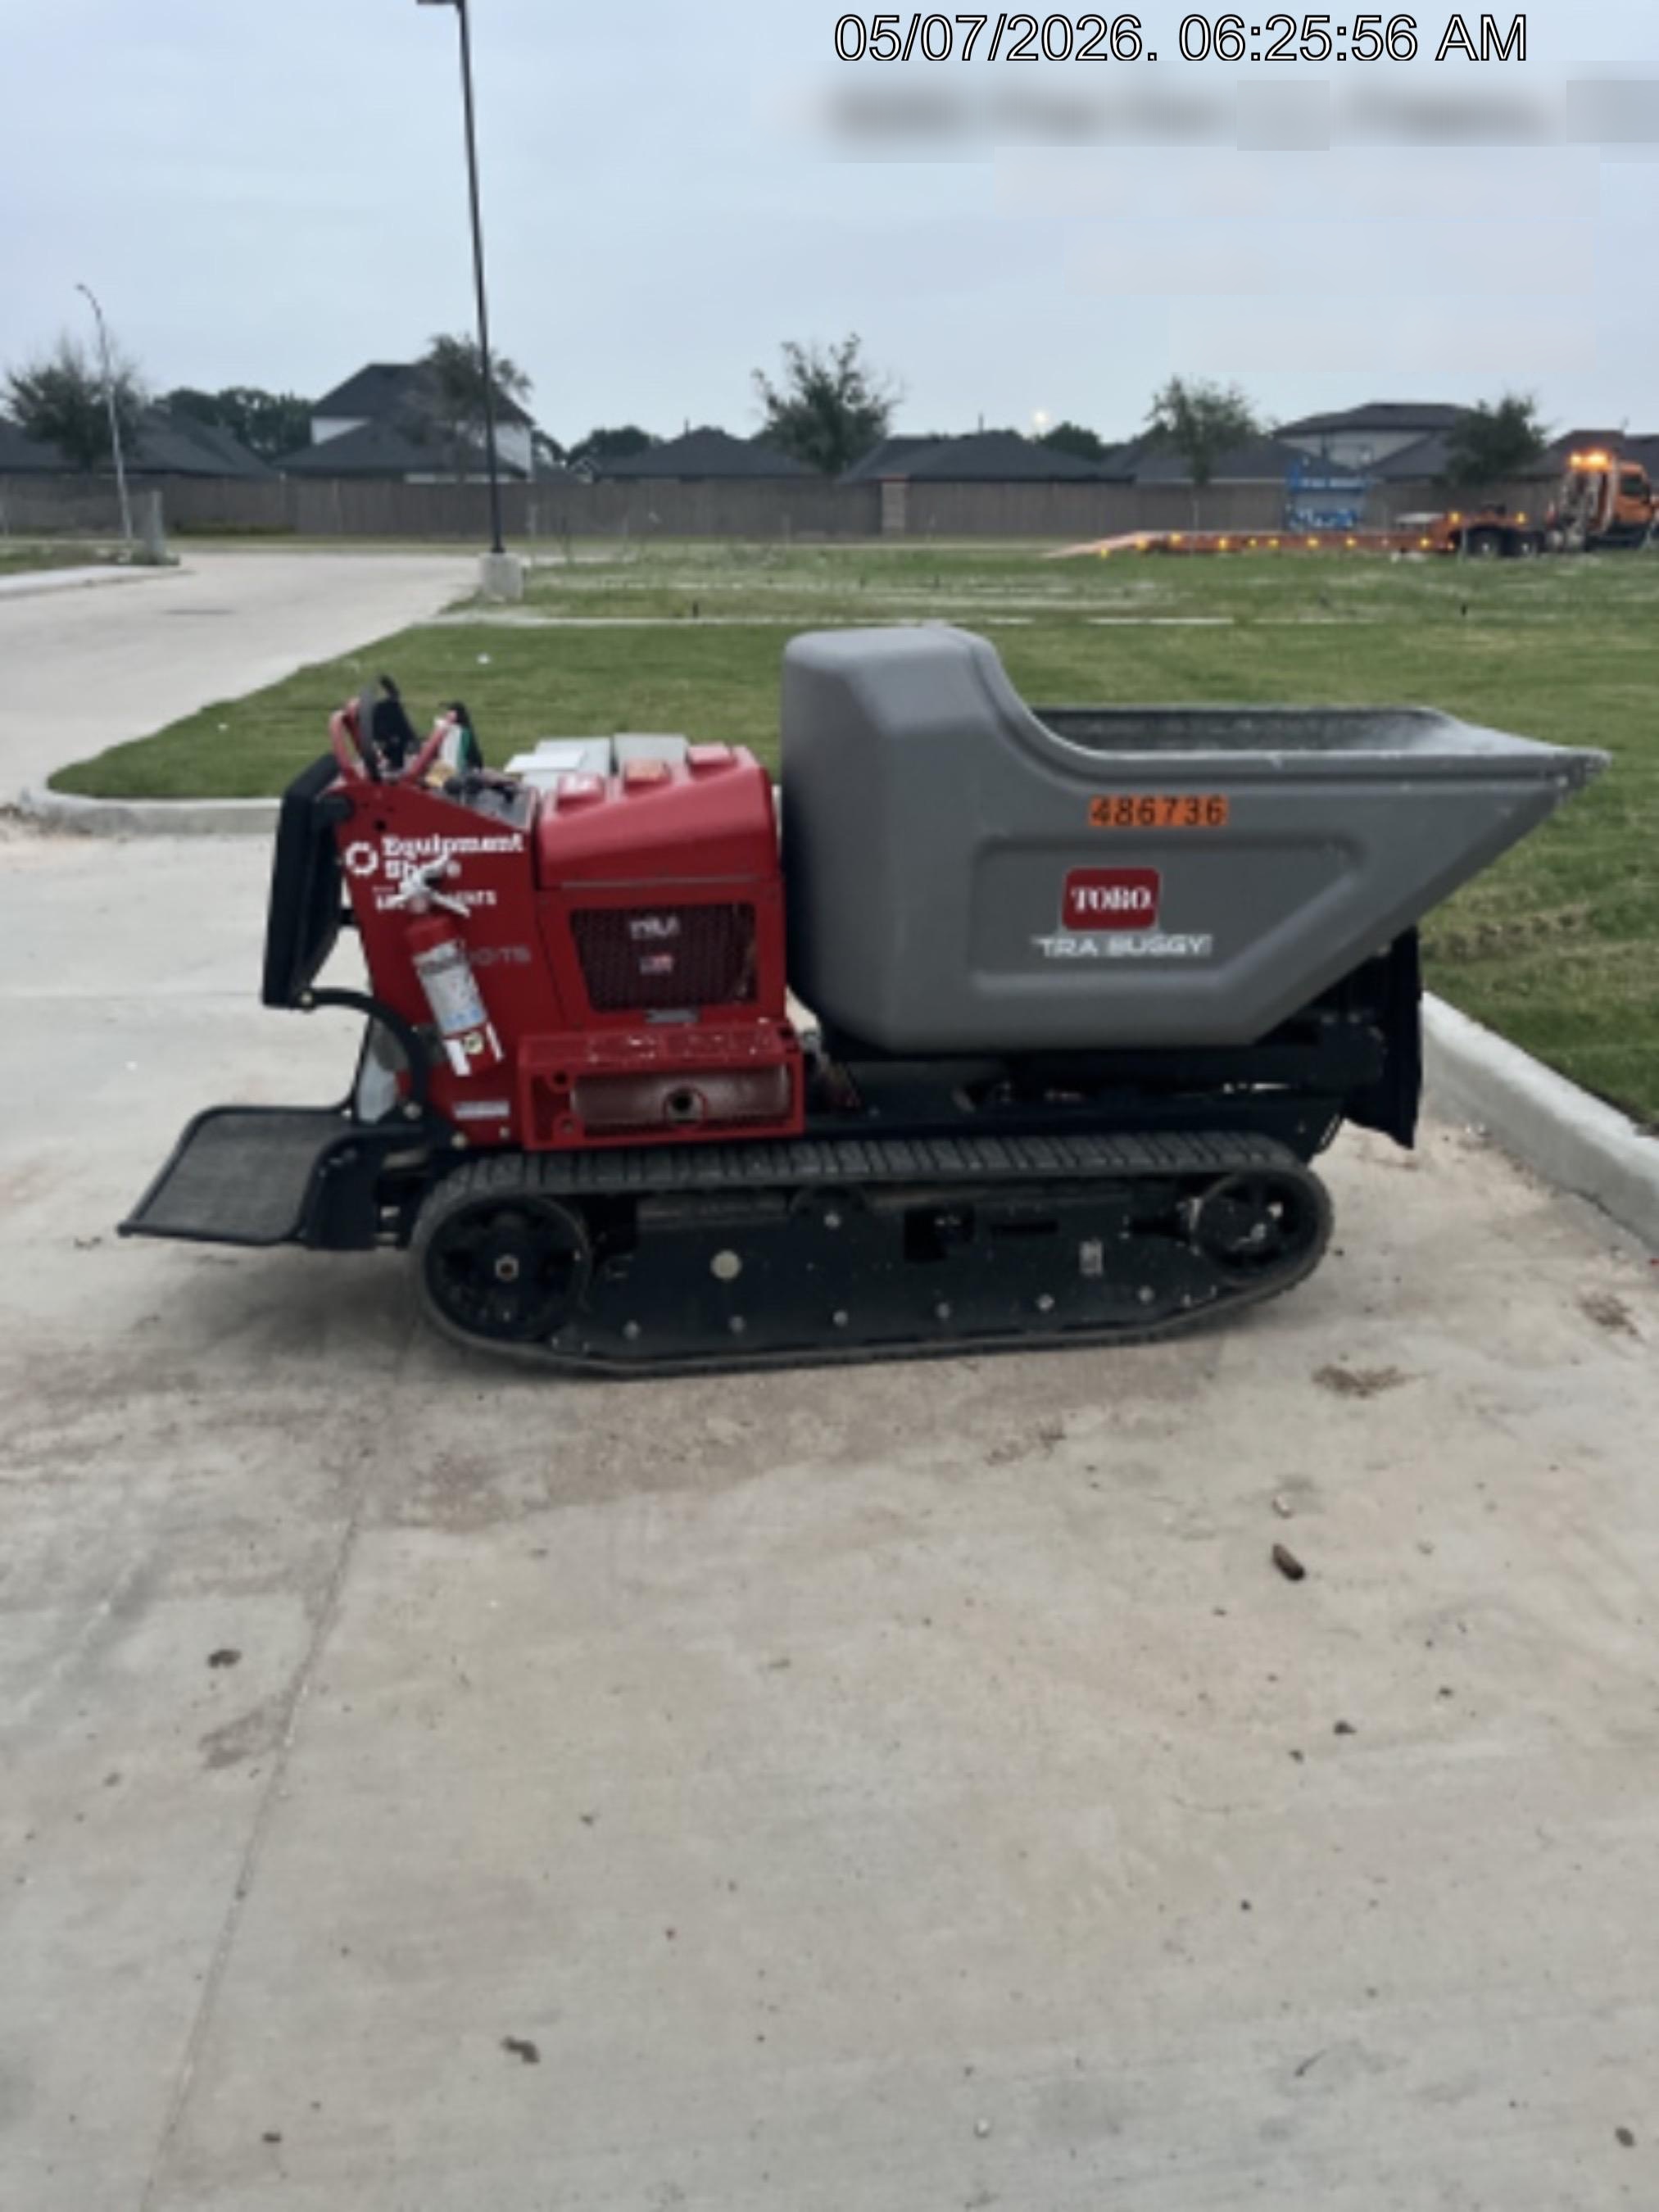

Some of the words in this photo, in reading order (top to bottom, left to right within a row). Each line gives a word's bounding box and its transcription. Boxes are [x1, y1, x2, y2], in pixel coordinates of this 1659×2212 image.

[1090, 794, 1225, 826] 486736
[382, 834, 524, 858] Equipment
[1071, 886, 1152, 912] TORO
[1108, 934, 1212, 957] BUGGY
